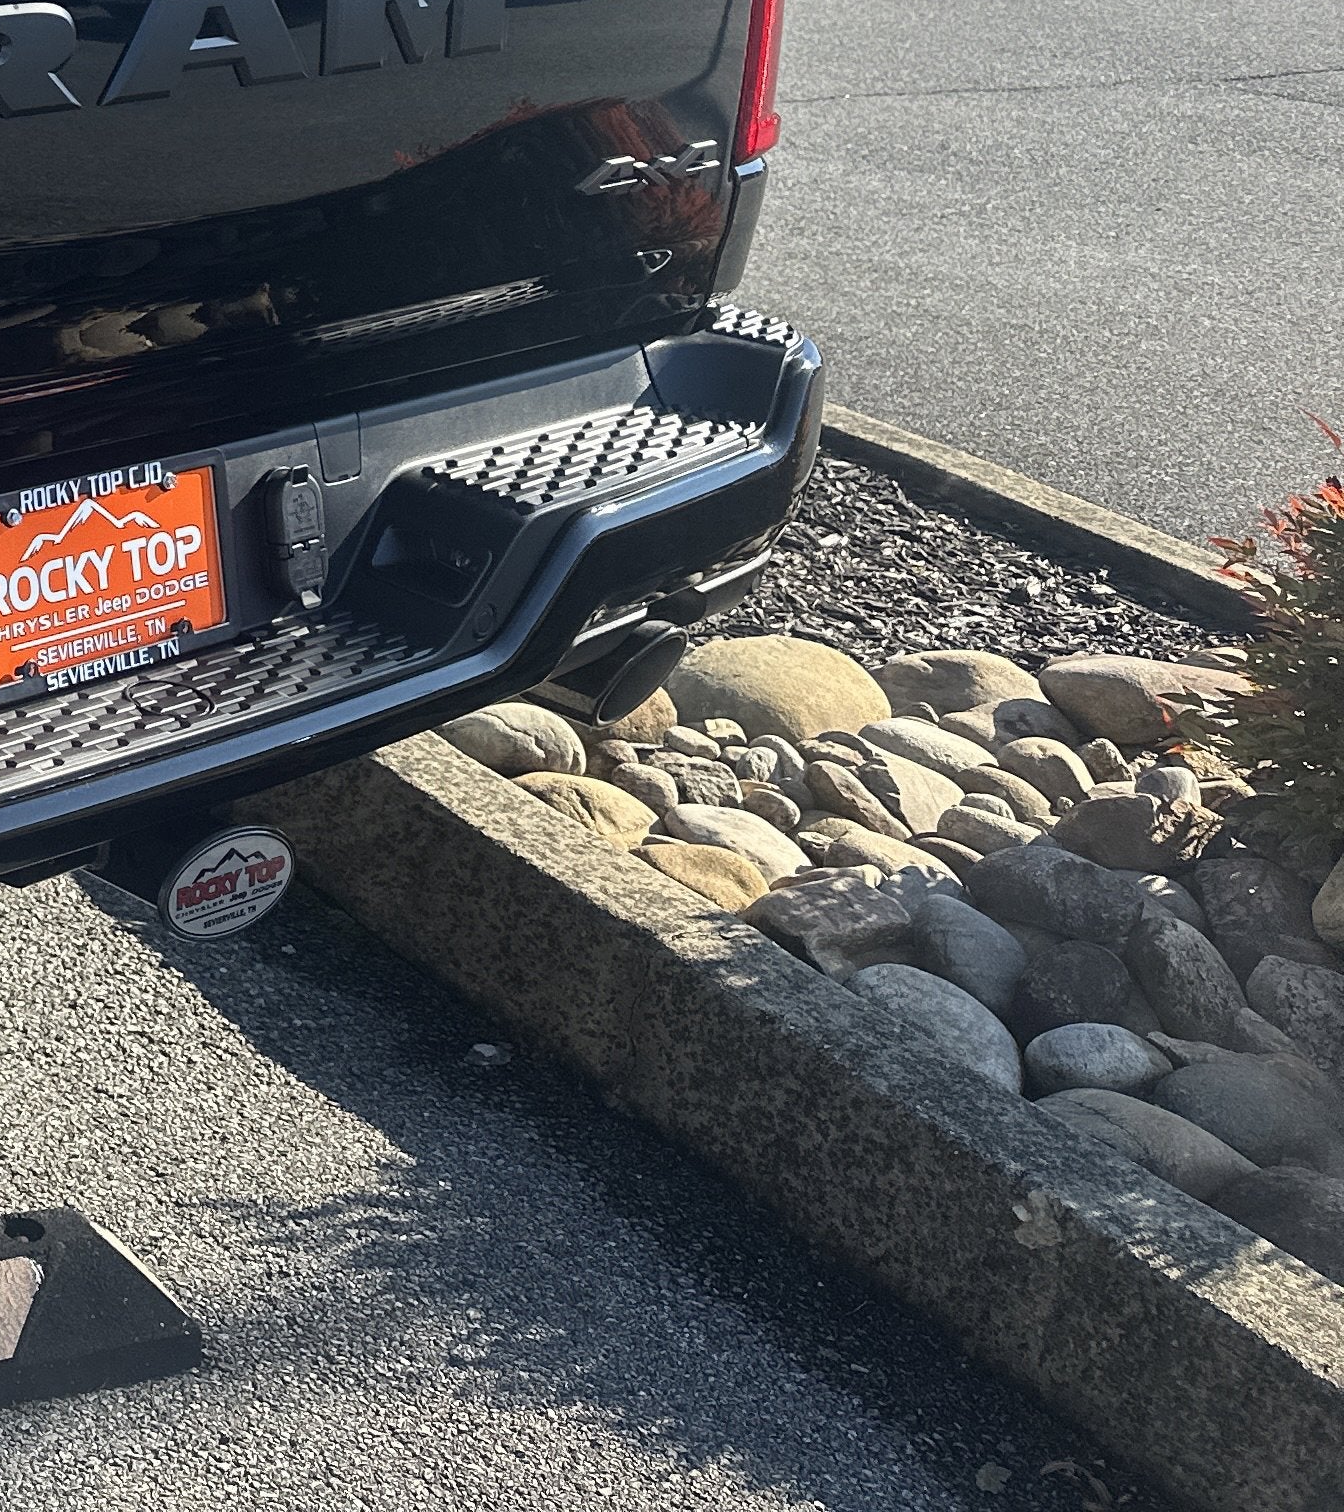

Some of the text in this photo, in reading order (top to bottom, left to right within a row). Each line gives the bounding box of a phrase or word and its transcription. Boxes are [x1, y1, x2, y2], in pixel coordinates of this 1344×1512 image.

[20, 461, 163, 514] ROCKY TOP CJD
[122, 524, 202, 584] TOP
[94, 592, 132, 618] Jeep
[135, 570, 209, 606] DODGE
[36, 616, 167, 667] SEVIERVILLE, TN
[46, 638, 181, 693] SEVIERVILLE, TN
[176, 855, 285, 911] ROCKY TOP
[248, 904, 257, 913] TN
